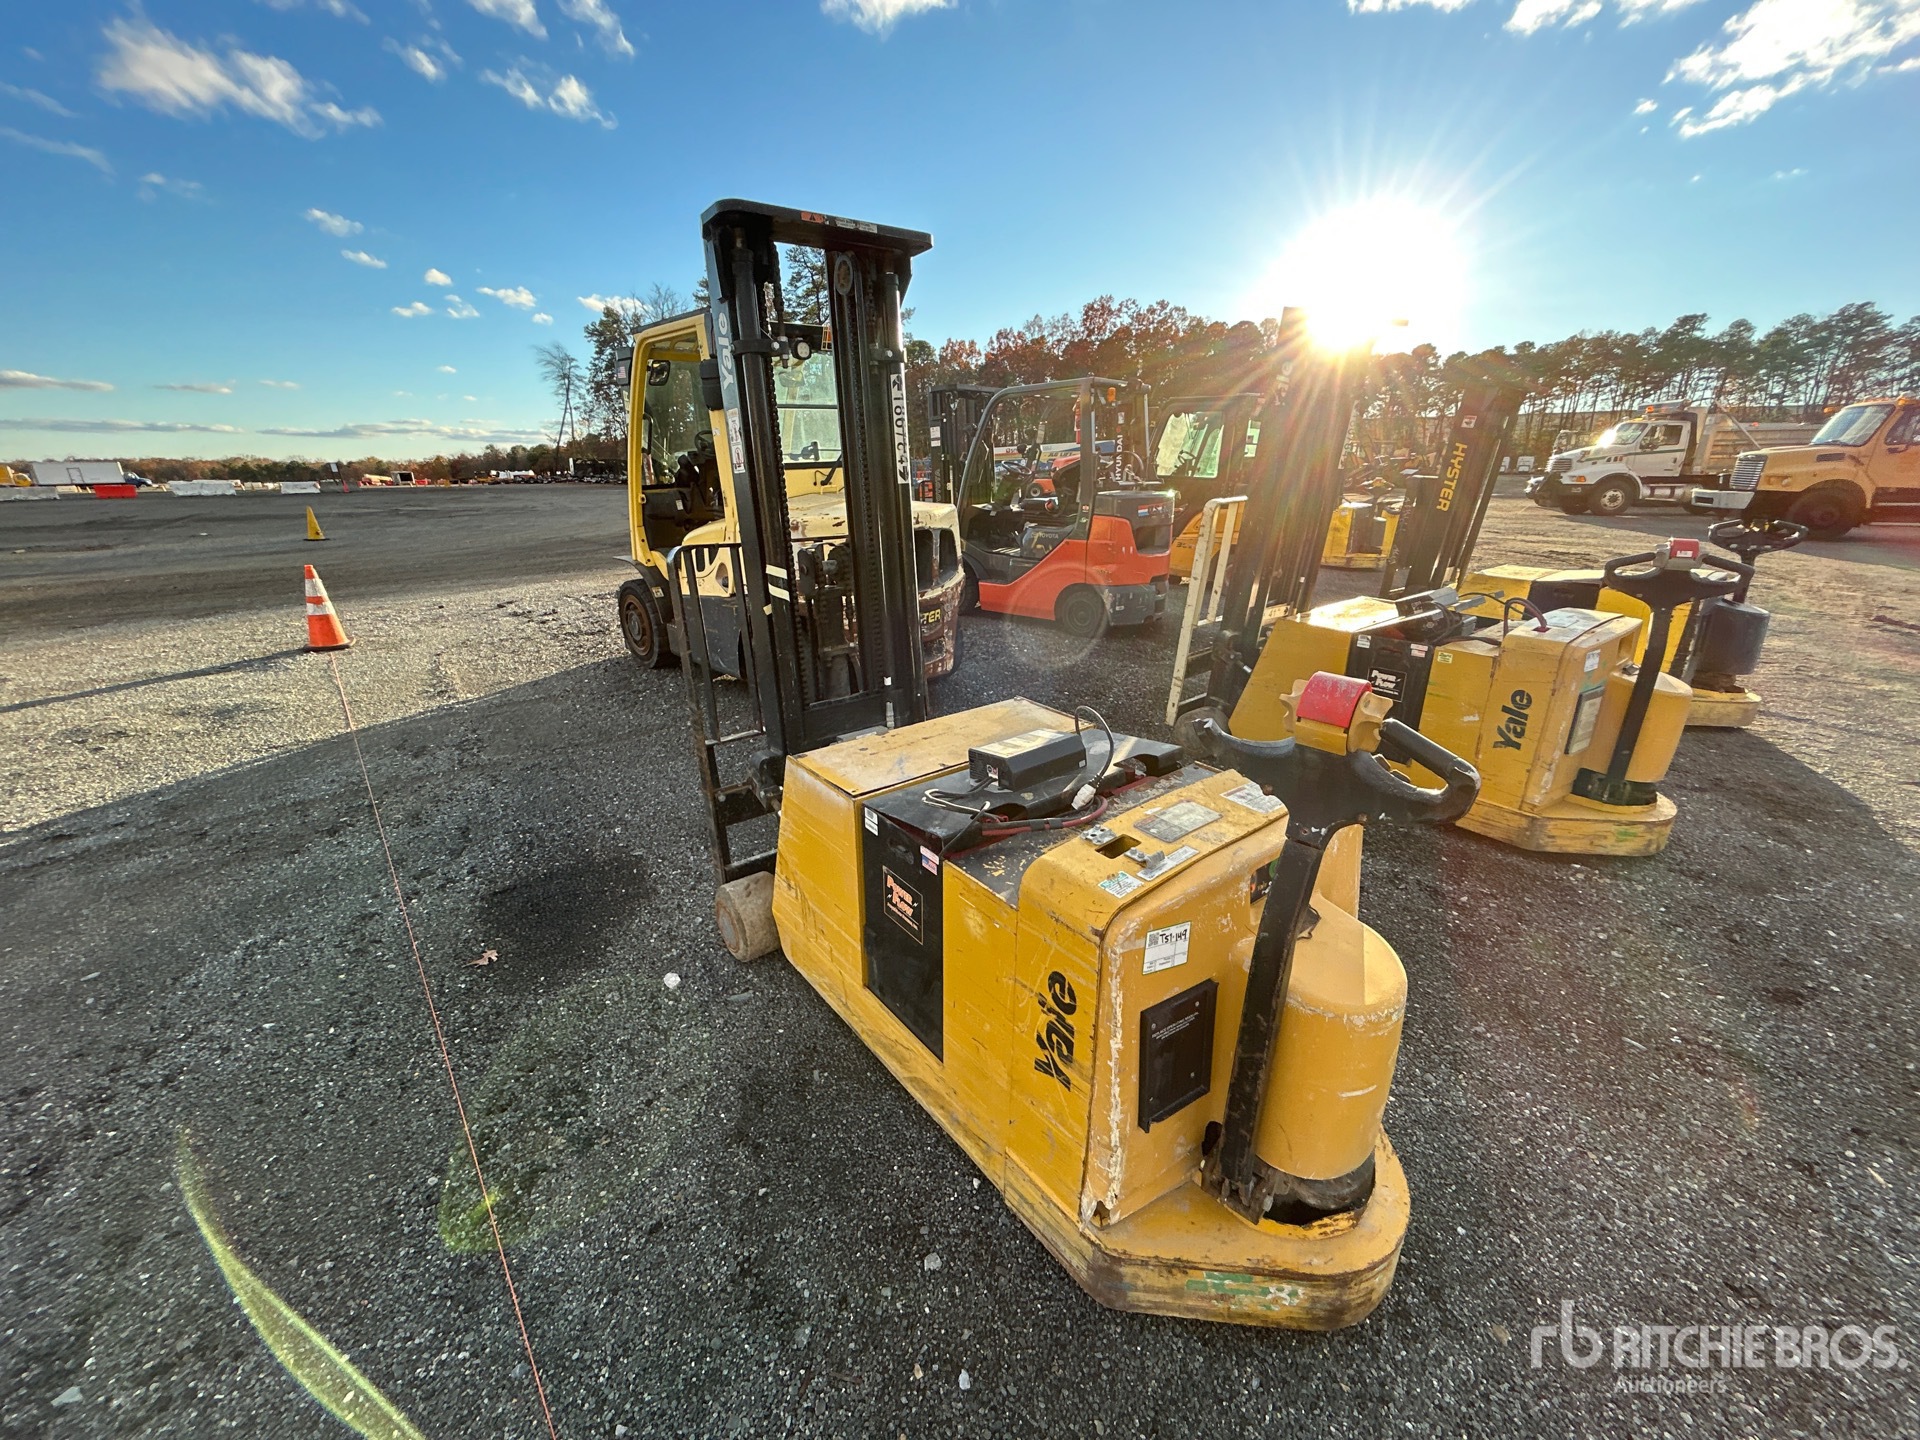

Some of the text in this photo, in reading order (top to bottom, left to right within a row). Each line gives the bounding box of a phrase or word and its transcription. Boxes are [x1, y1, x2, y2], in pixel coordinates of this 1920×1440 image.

[718, 312, 734, 390] Yale
[1115, 434, 1123, 480] HYUNDAI
[1436, 442, 1468, 511] HYSTER
[1493, 689, 1533, 751] Yale
[1034, 970, 1078, 1093] Yale
